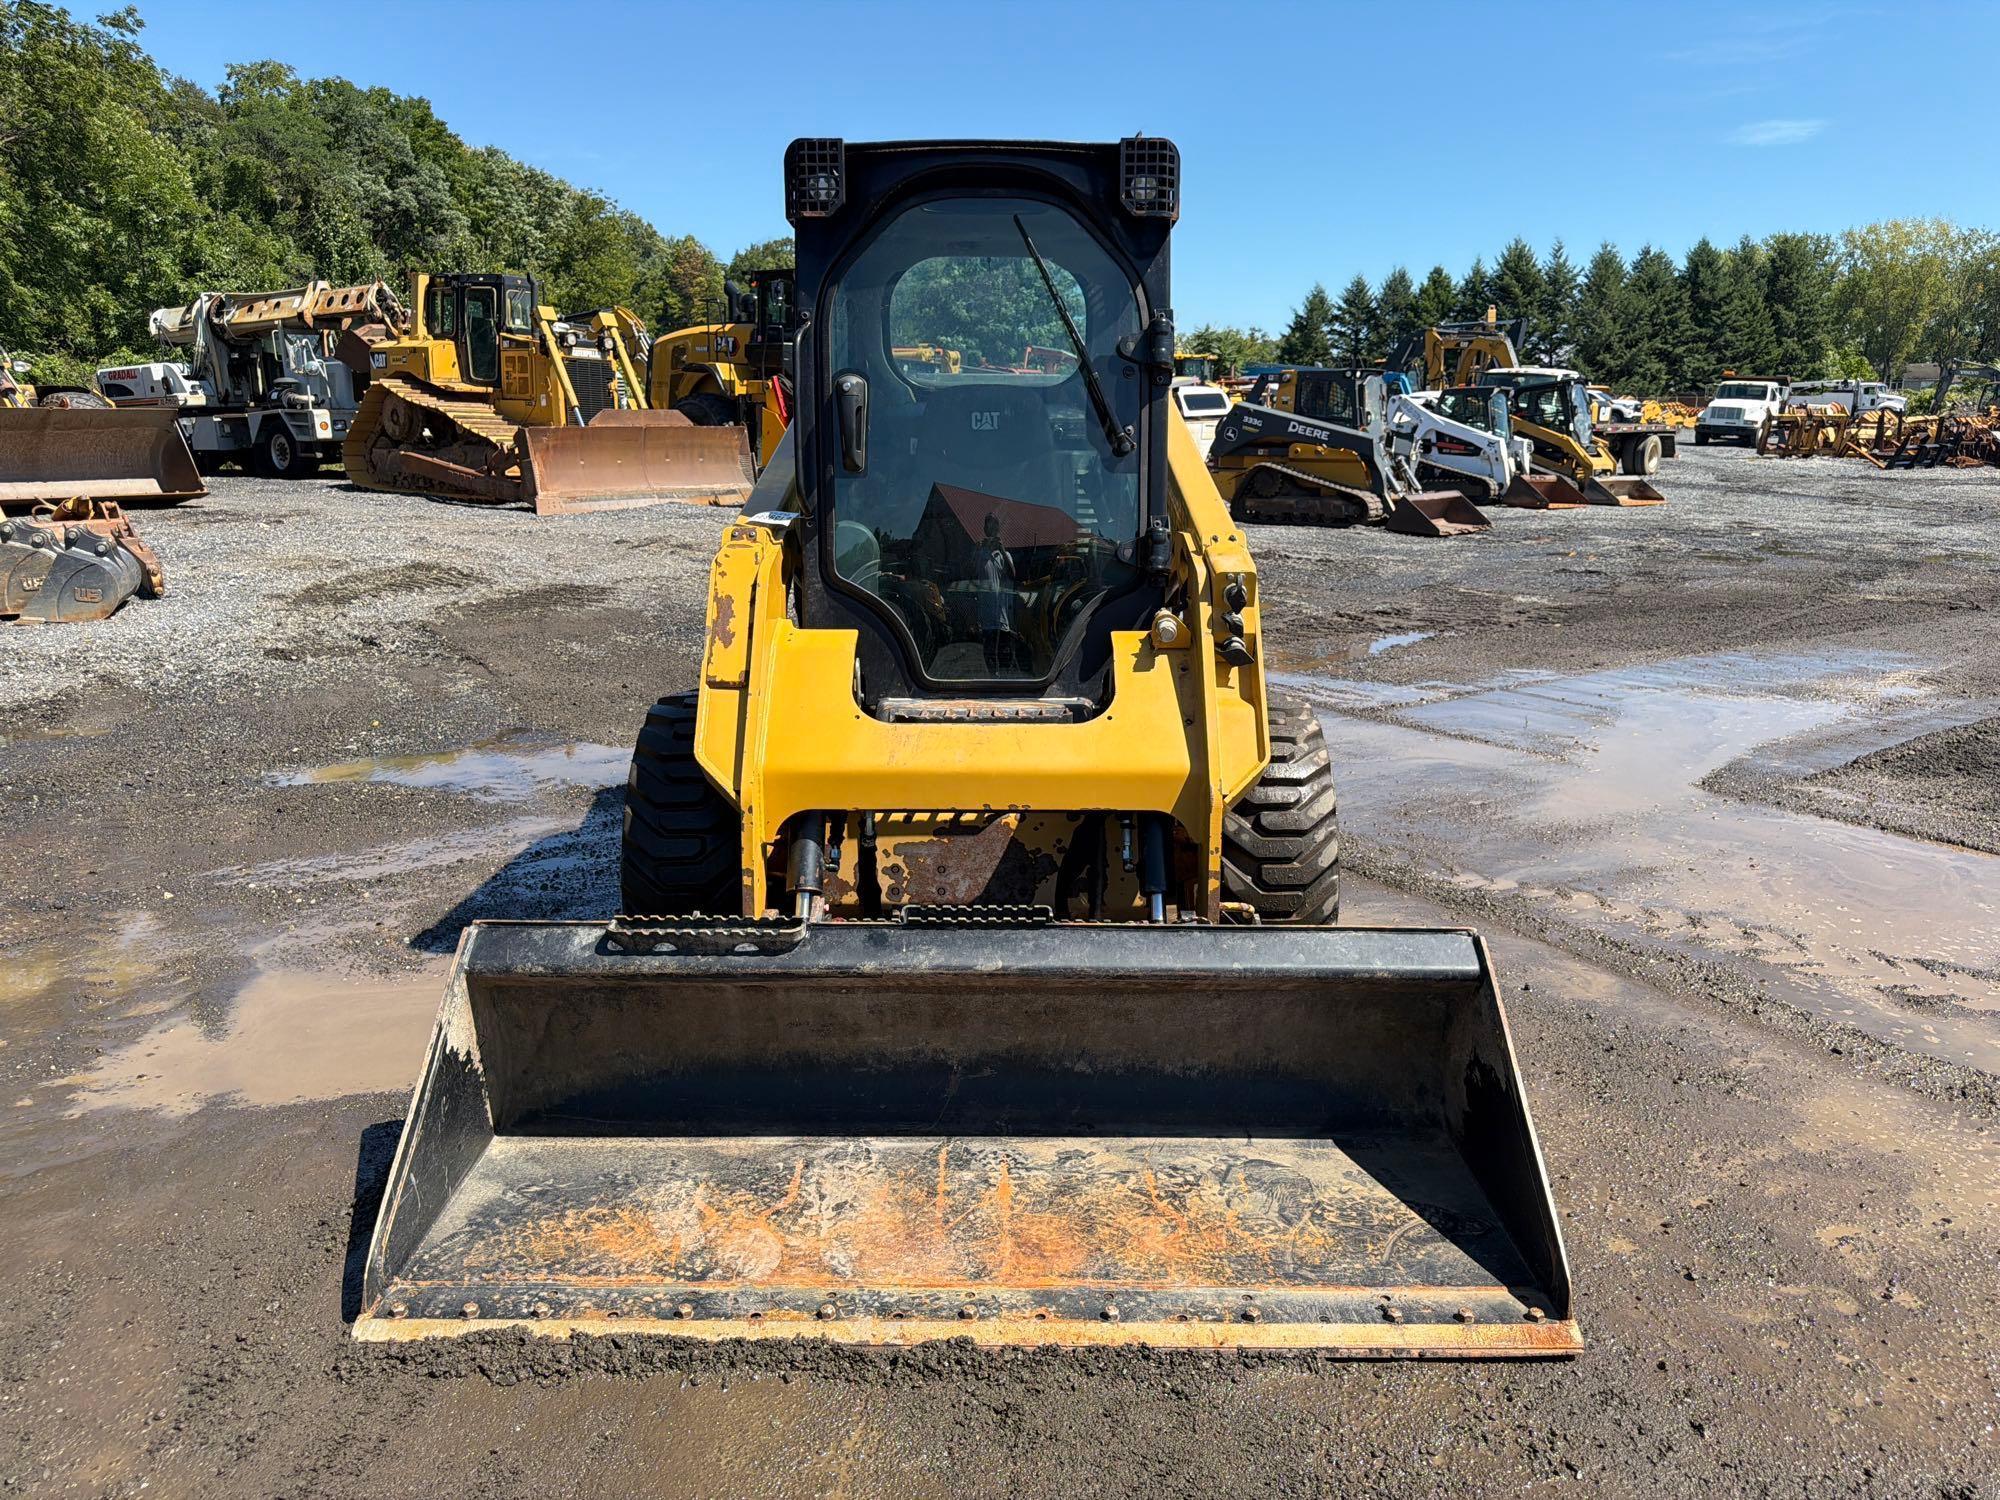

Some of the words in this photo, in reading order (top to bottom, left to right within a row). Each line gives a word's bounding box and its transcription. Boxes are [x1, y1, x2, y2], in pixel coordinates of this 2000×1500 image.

[374, 353, 387, 368] CAT
[108, 368, 138, 380] GRADALL
[971, 411, 1001, 430] CAT
[1243, 415, 1263, 427] 333G
[1287, 421, 1331, 441] DEERE
